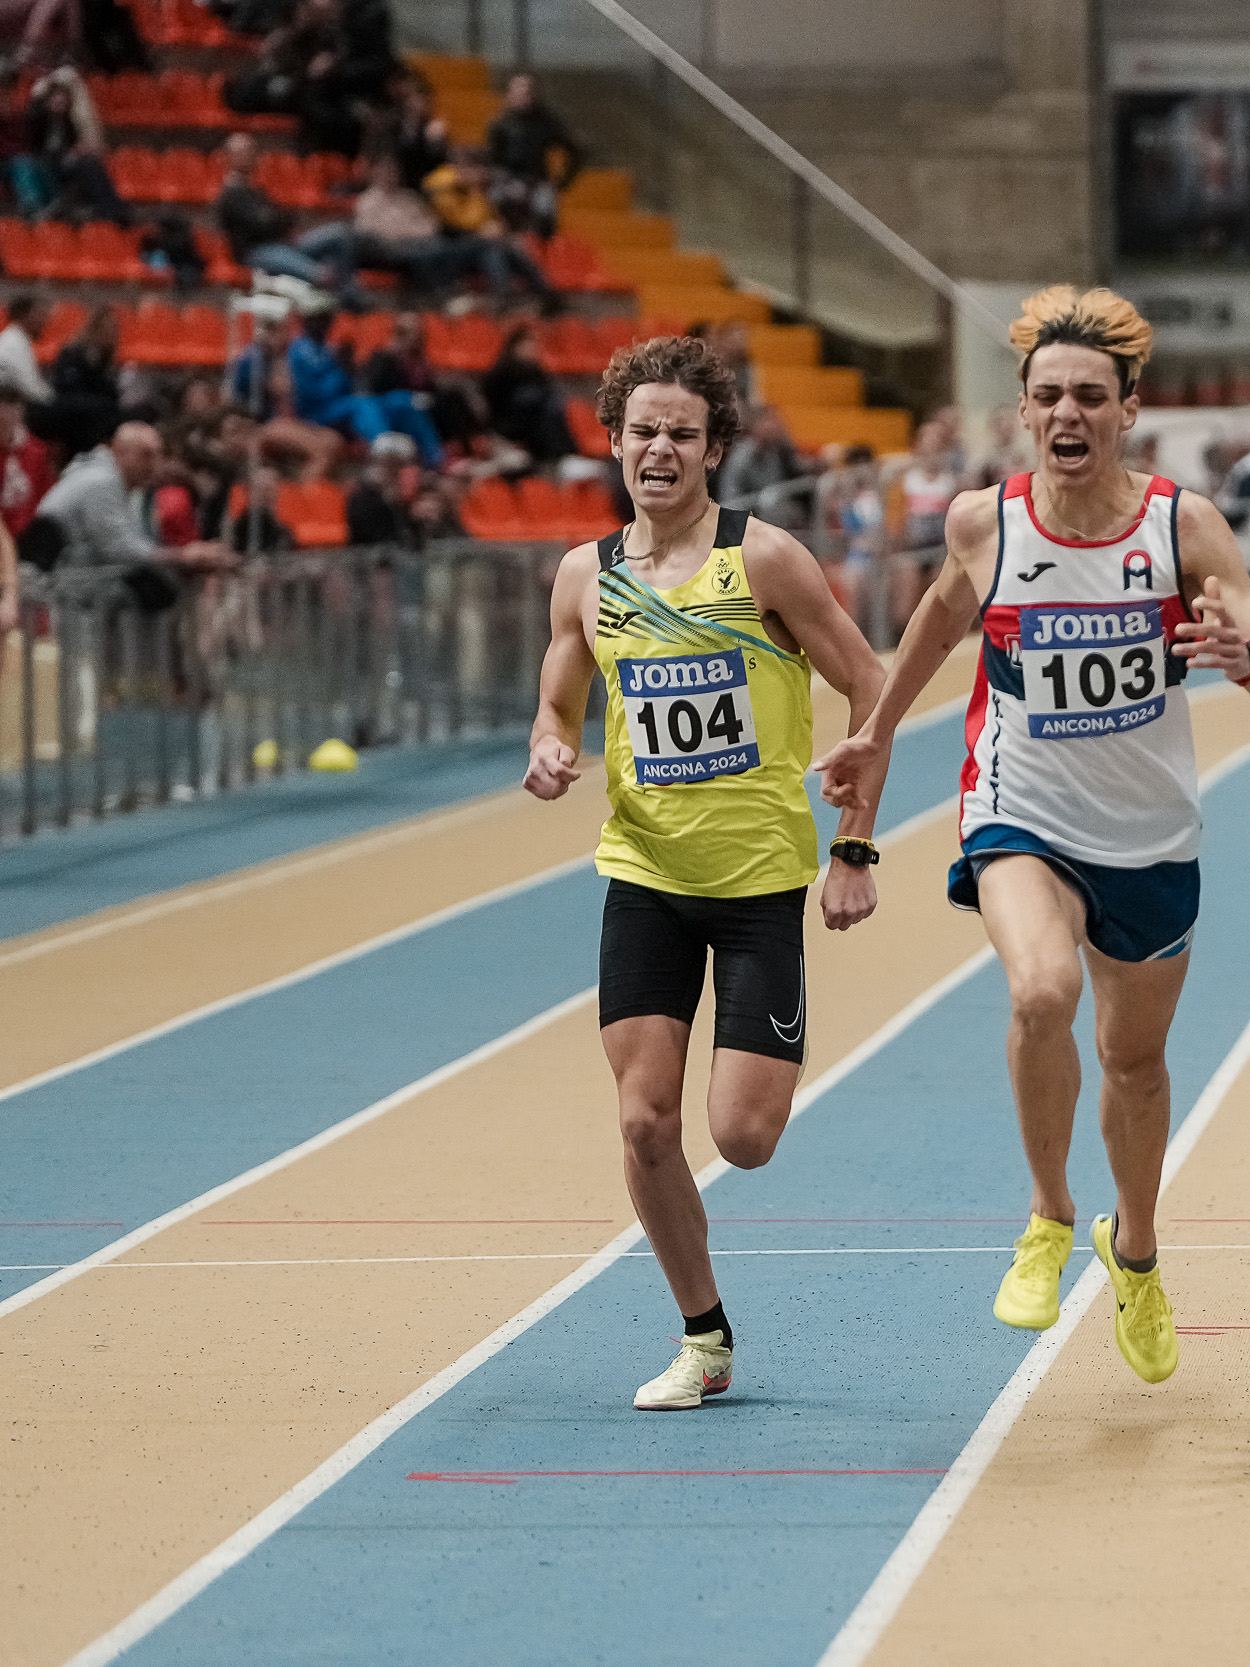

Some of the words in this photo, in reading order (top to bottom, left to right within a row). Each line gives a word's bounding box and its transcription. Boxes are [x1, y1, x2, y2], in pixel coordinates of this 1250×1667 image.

[1041, 646, 1156, 710] 103
[636, 691, 744, 755] 104
[1041, 715, 1116, 735] ANCONA
[1119, 705, 1157, 727] 2024
[643, 759, 706, 778] ANCONA
[708, 752, 748, 771] 2024
